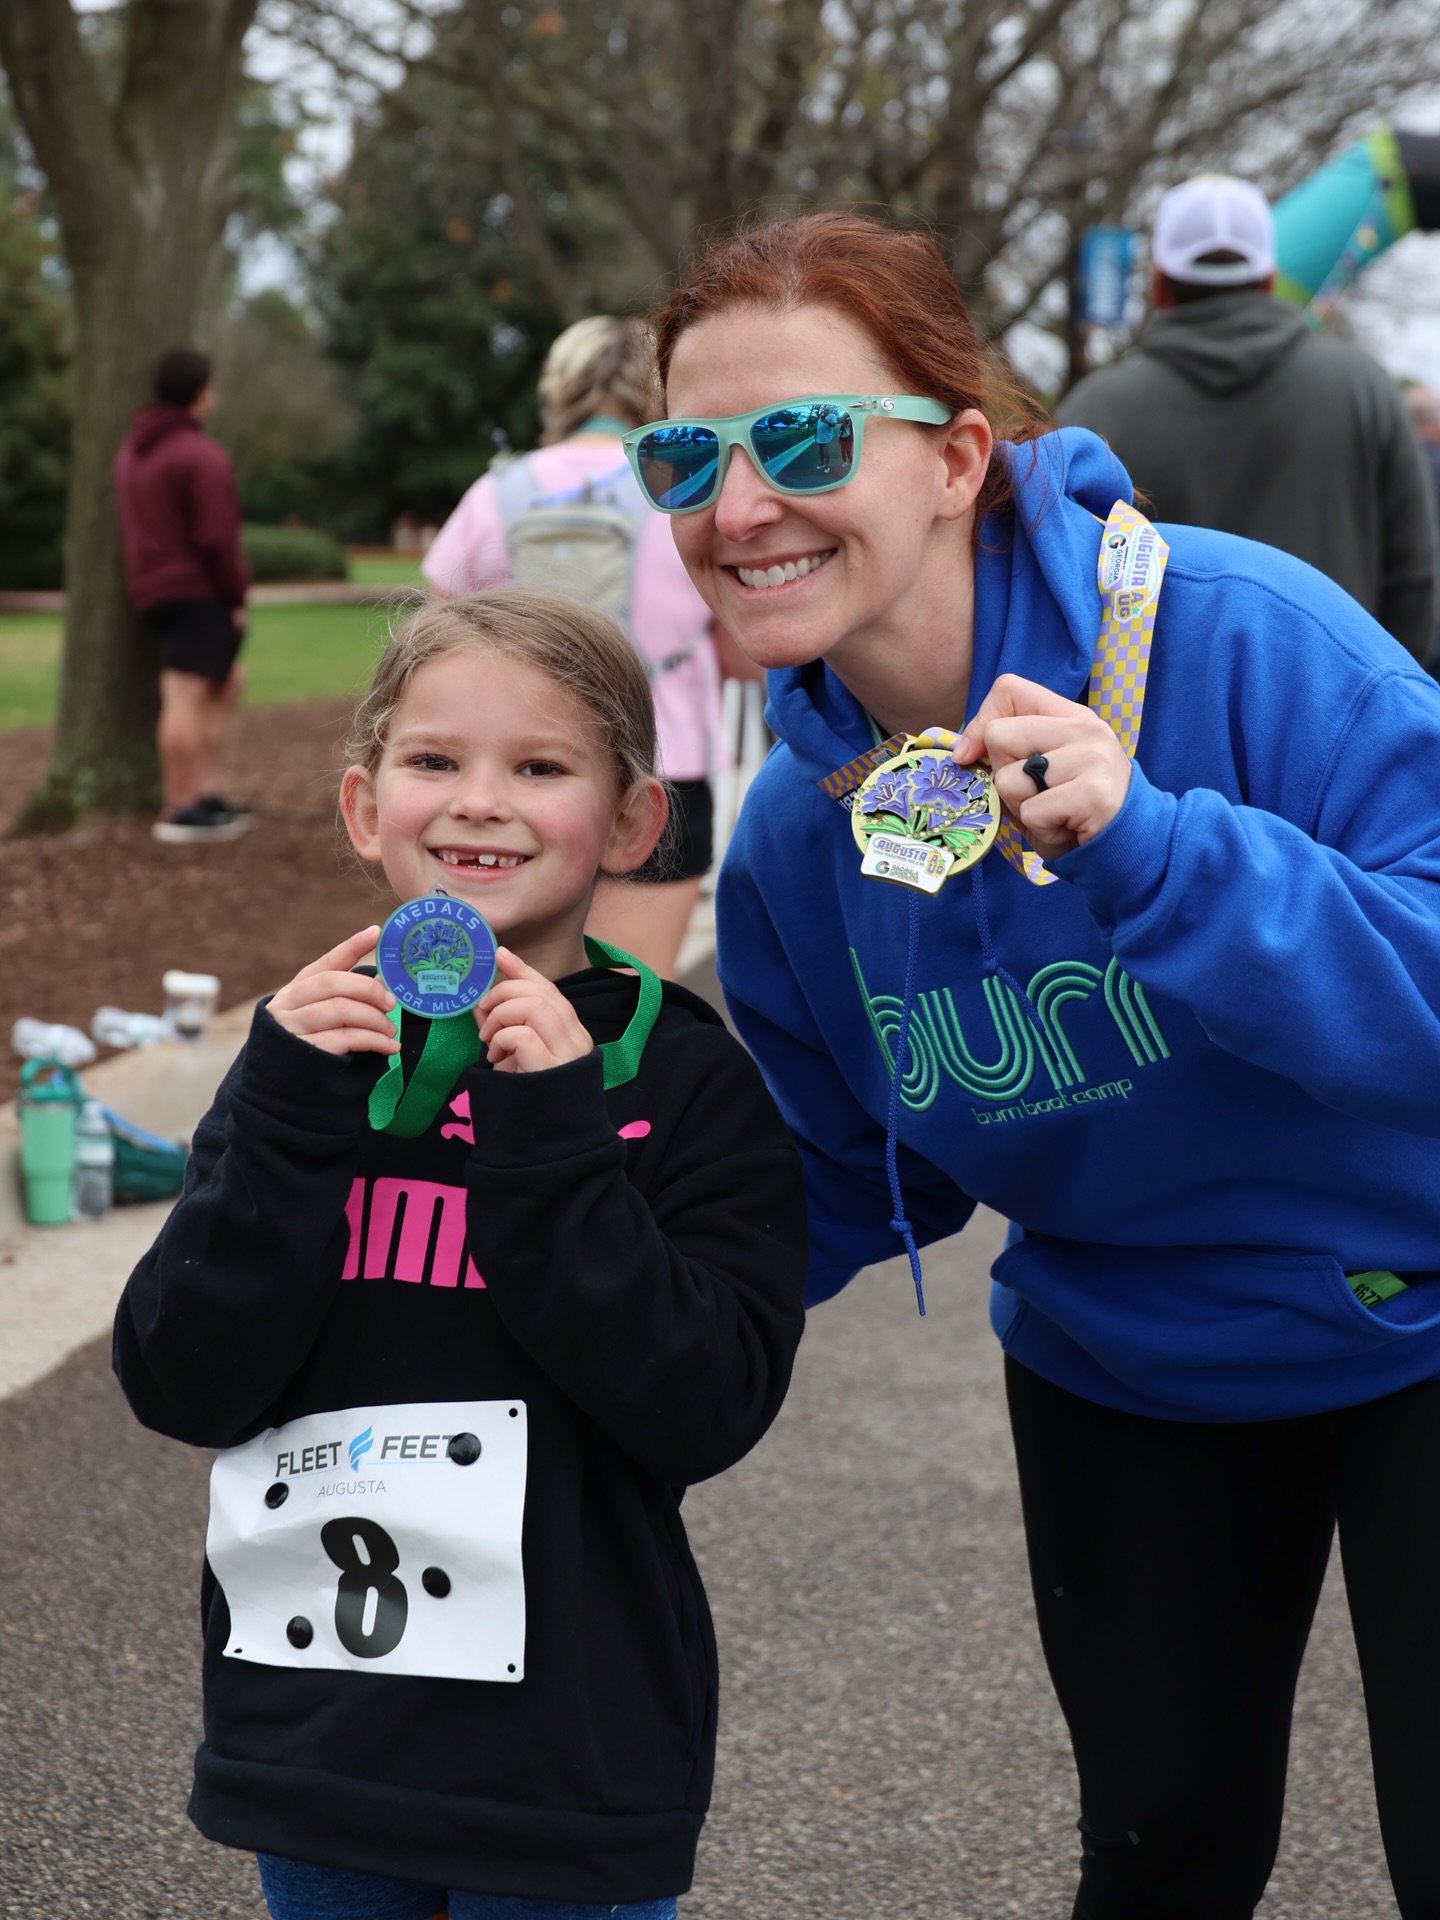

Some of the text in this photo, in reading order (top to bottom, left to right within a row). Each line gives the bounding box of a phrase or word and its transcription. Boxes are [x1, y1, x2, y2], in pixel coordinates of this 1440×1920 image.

[1130, 527, 1157, 586] AUGUSTA
[876, 839, 927, 862] AUGUSTA
[394, 901, 480, 930] MEDALS
[394, 984, 479, 1012] FOR MILES
[1071, 1078, 1133, 1104] camp
[275, 1434, 452, 1478] FLEET FEET
[316, 1480, 387, 1498] AUGUSTA
[320, 1516, 408, 1659] 8
